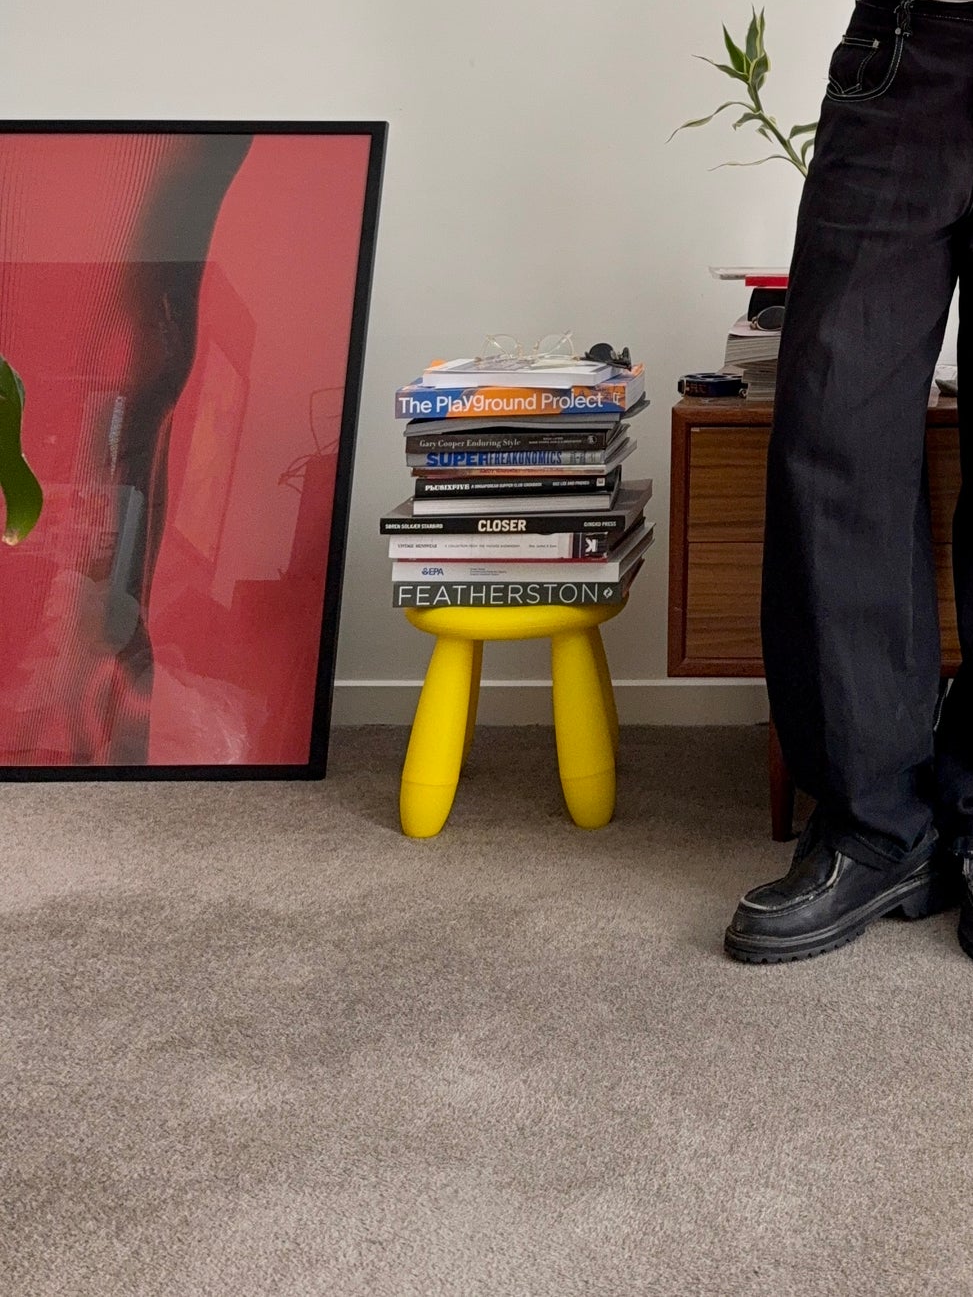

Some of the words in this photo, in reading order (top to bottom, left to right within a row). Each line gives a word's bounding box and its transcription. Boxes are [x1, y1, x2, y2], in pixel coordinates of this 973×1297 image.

[398, 397, 433, 414] The
[436, 393, 538, 413] Playground
[541, 389, 604, 410] Project
[419, 440, 436, 450] Gary
[438, 439, 465, 449] Cooper
[466, 439, 502, 449] Enduring
[502, 438, 522, 448] Style
[478, 519, 527, 532] CLOSER
[429, 568, 445, 576] EPA
[398, 583, 599, 606] FEATHERSTON
